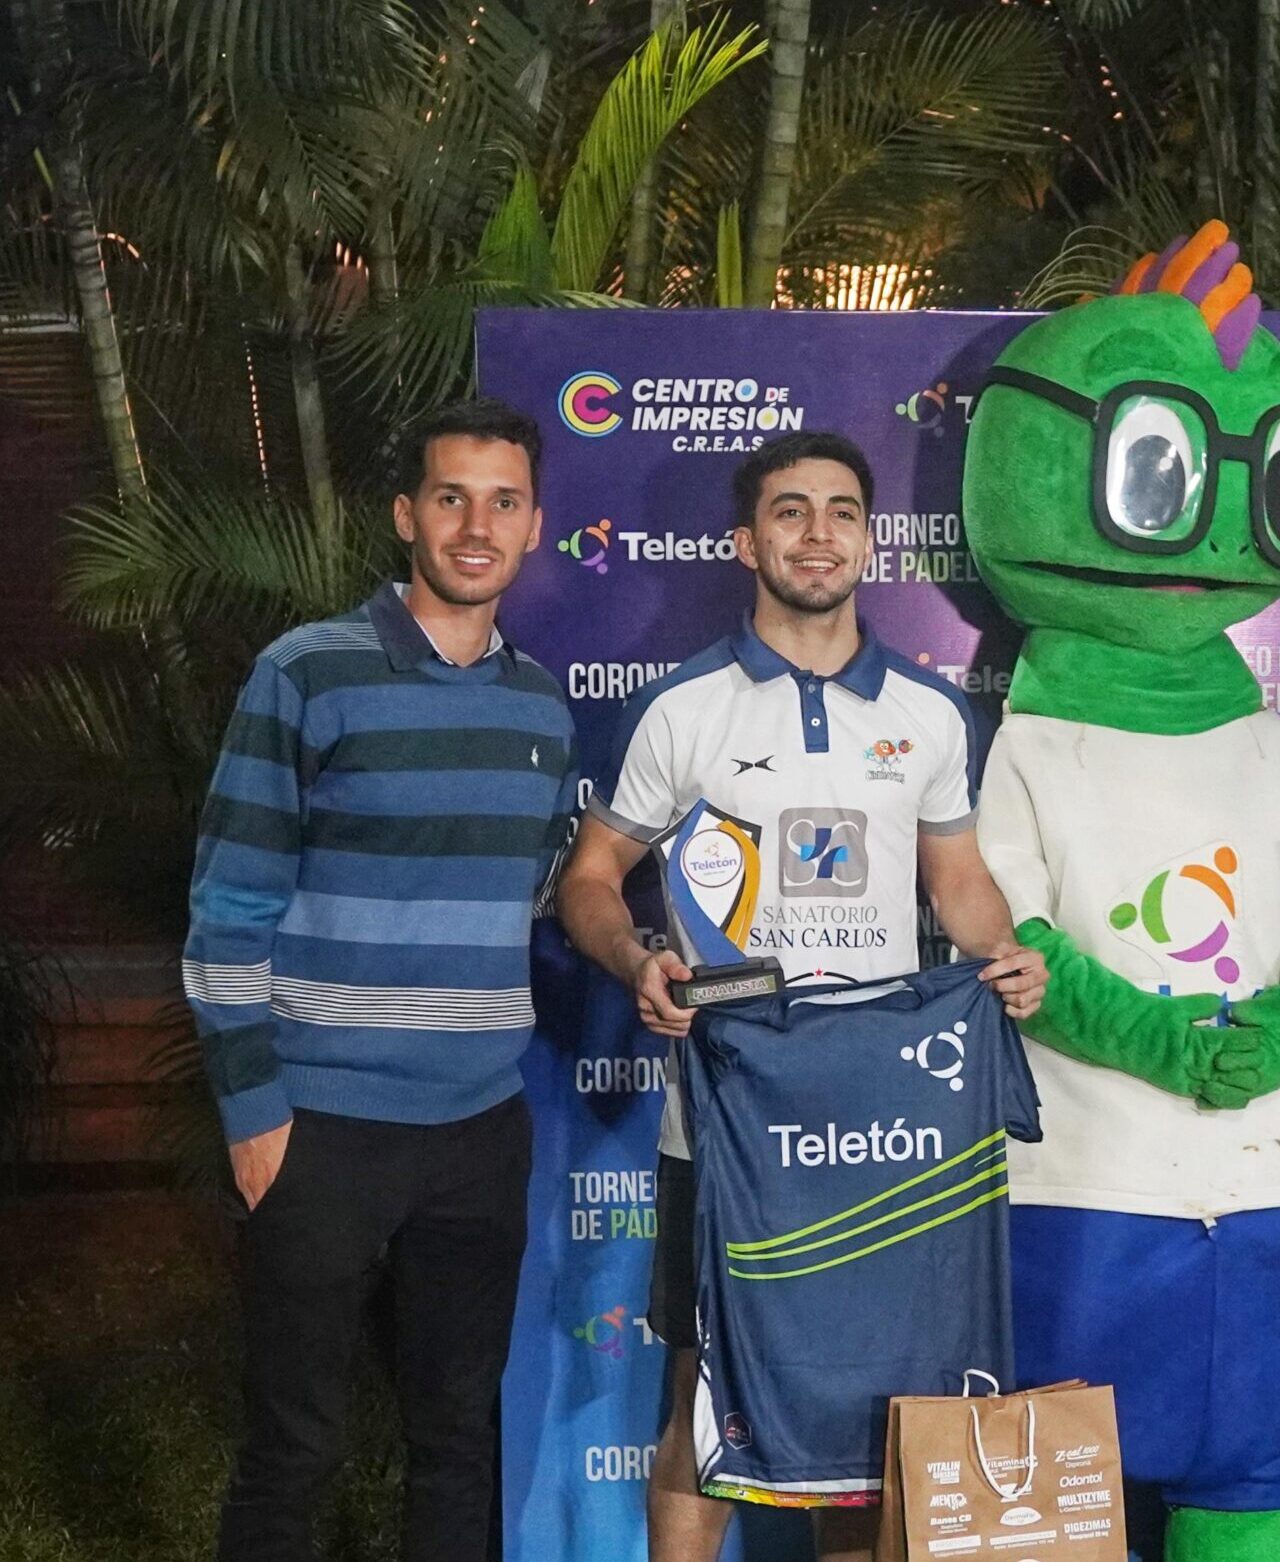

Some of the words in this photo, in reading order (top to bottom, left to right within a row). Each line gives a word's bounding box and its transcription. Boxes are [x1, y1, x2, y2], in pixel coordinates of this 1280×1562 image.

[632, 378, 758, 402] CENTRO
[765, 387, 789, 402] DE
[632, 402, 804, 430] IMPRESIÓN
[618, 530, 737, 561] Teletó
[690, 857, 737, 871] Teletón
[763, 904, 878, 925] SANATORIO
[750, 927, 798, 948] SAN
[801, 926, 887, 948] CARLOS
[692, 978, 767, 998] FINALISTA
[768, 1118, 943, 1168] Teletón
[572, 1209, 604, 1241] DE
[611, 1202, 658, 1240] PÁD
[927, 1460, 961, 1473] VITALIN
[1059, 1472, 1103, 1488] Odontol
[1057, 1490, 1112, 1507] MULTIZYME
[1063, 1518, 1111, 1534] DIGEZIMAS
